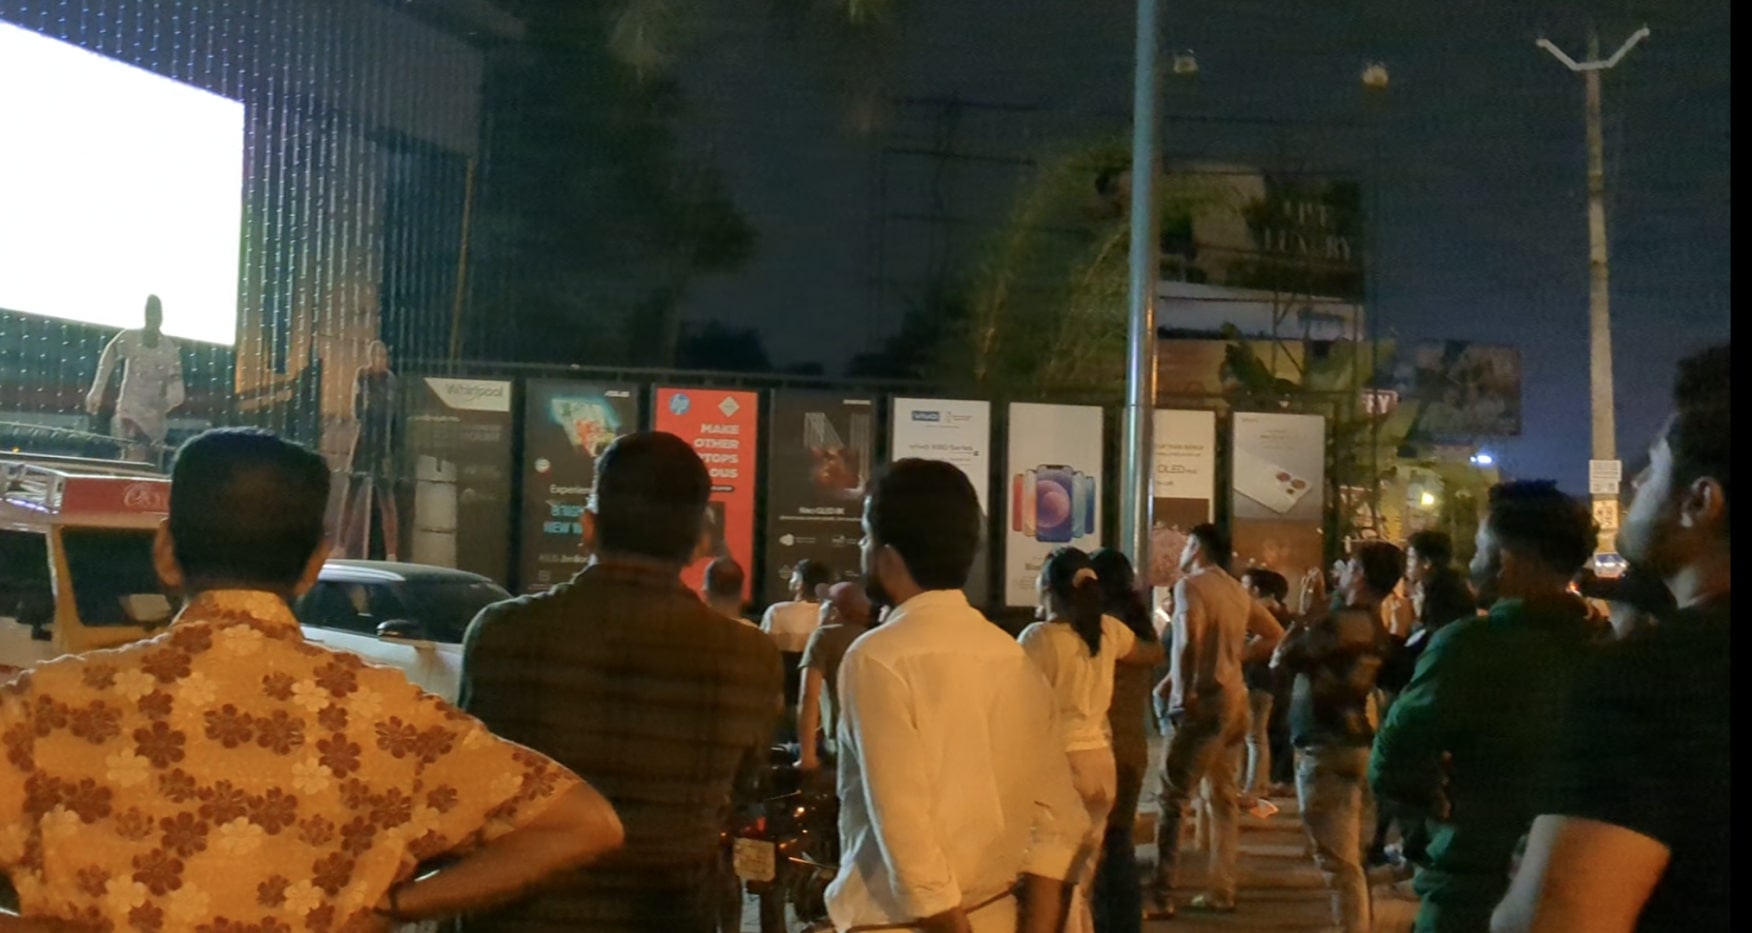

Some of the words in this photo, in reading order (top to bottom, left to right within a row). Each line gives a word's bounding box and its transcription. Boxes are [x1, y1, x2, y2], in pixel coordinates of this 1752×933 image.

[446, 382, 504, 400] Whirlpool
[700, 423, 740, 435] MAKE
[693, 438, 740, 450] OTHER
[550, 484, 592, 496] Experien
